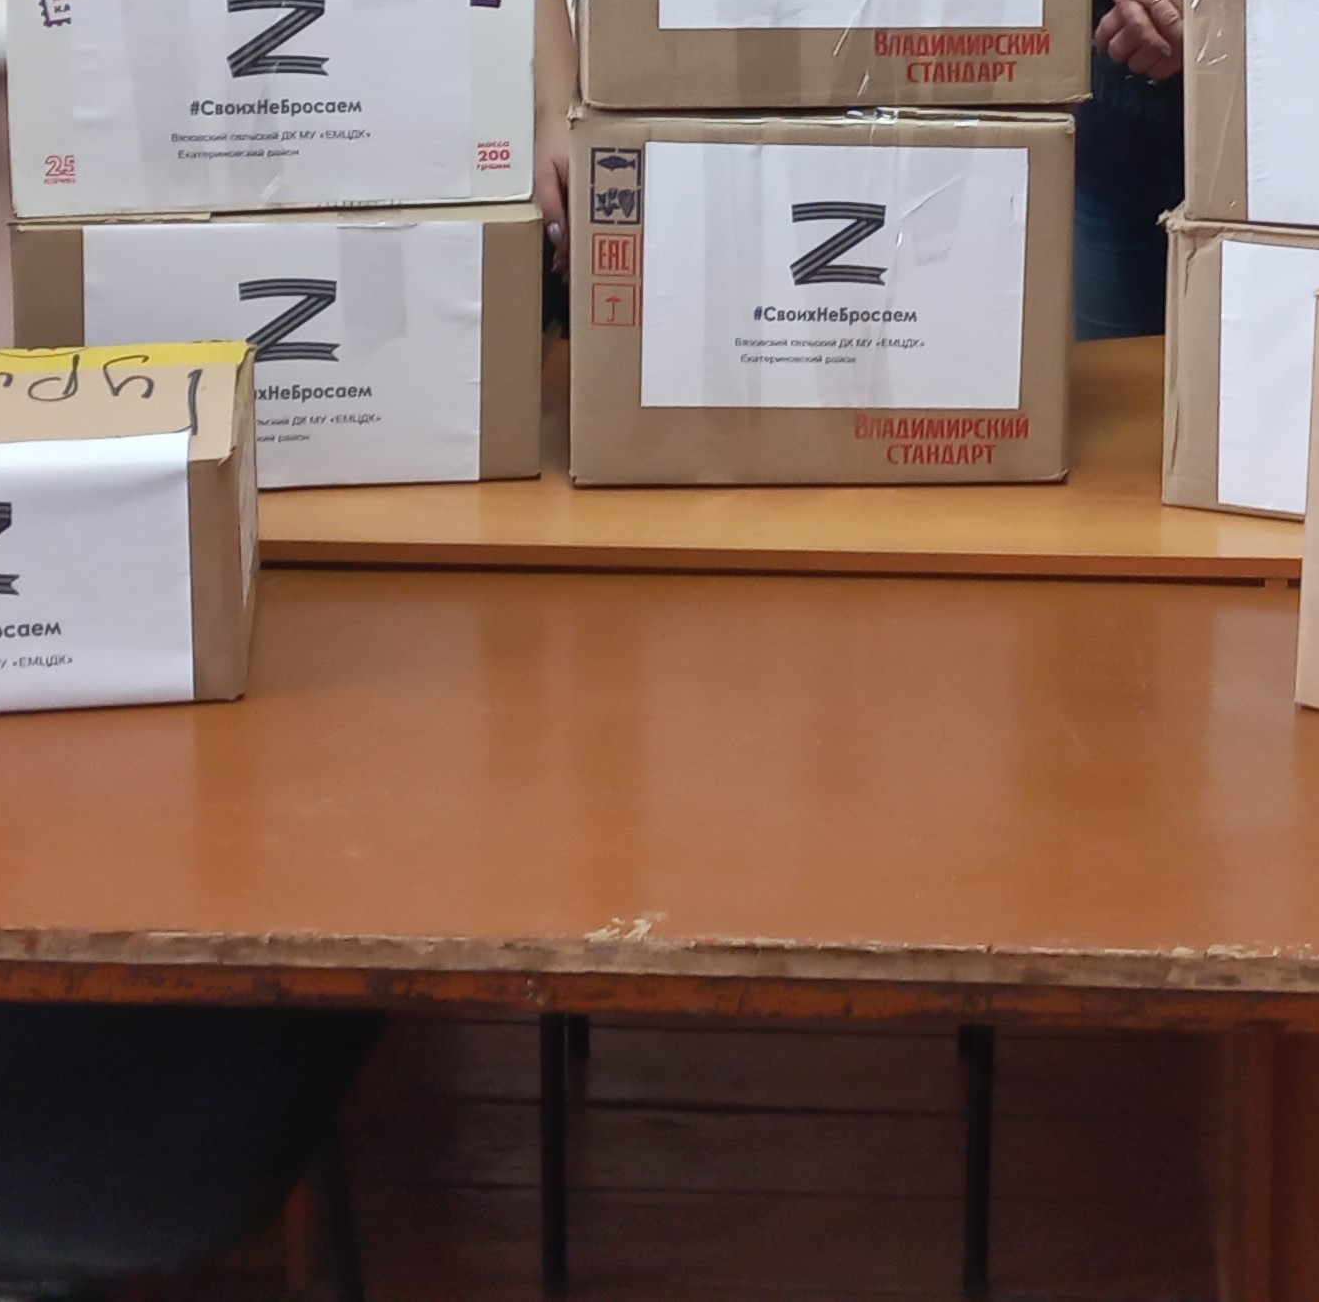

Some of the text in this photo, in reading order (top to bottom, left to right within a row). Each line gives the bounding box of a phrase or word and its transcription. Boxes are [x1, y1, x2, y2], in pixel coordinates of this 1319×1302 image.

[874, 29, 1050, 56] ВЛАДИМИРСКИЙ
[907, 61, 1017, 83] СТАНДАРТ
[190, 99, 362, 116] #СвоихНеБросаем
[281, 131, 297, 141] ДК
[299, 131, 316, 140] МУ
[478, 149, 510, 162] 200
[753, 306, 917, 325] #СвоихНеБросаем
[838, 338, 853, 348] ДК
[855, 338, 872, 347] МУ
[254, 385, 372, 403] хНеБросаем
[292, 416, 307, 426] ДК
[309, 415, 327, 424] МУ
[854, 413, 1029, 439] ВЛАДИМИРСКИЙ
[887, 444, 996, 465] СТАНДАРТ
